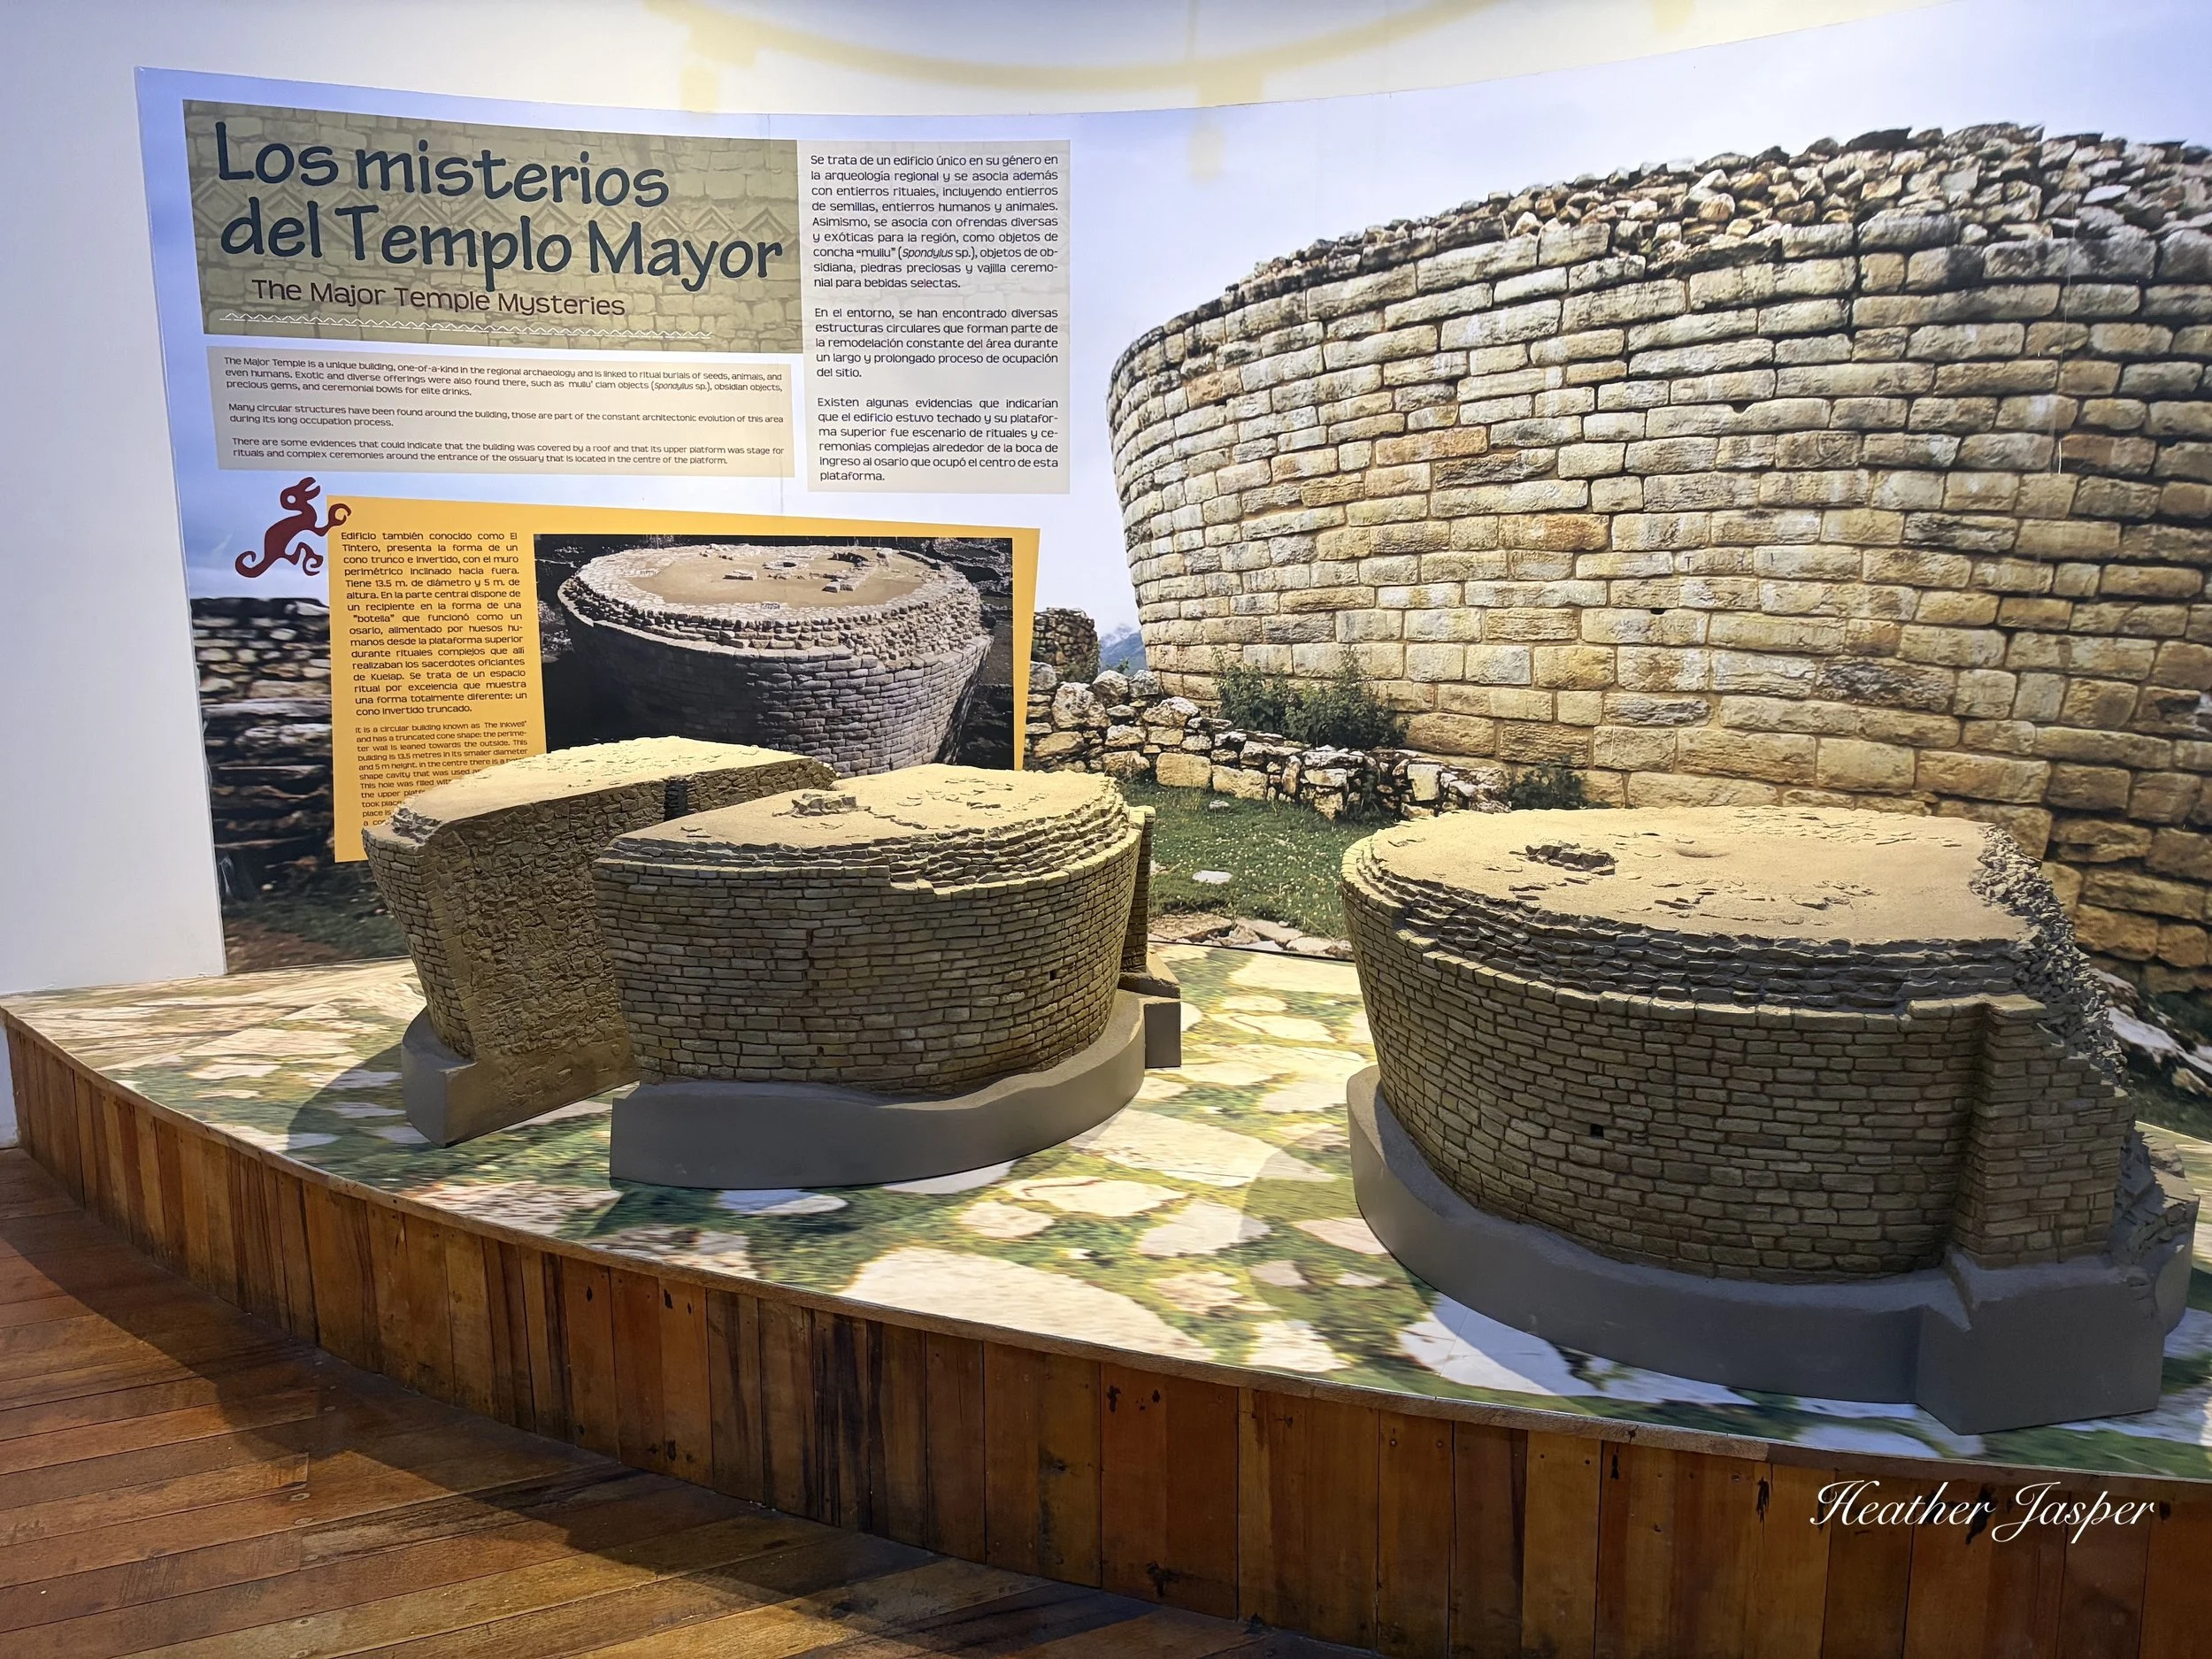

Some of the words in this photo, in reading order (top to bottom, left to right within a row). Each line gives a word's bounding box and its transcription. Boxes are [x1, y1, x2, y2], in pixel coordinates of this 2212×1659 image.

[215, 121, 339, 187] Los
[356, 139, 670, 208] misterios
[810, 155, 825, 165] Se
[827, 156, 857, 165] trata
[859, 156, 874, 165] de
[876, 157, 891, 165] un
[893, 156, 934, 166] edificio
[936, 156, 967, 166] único
[969, 157, 984, 166] en
[986, 157, 1000, 166] su
[1002, 155, 1042, 167] género
[1044, 156, 1058, 165] en
[811, 171, 821, 180] la
[825, 170, 891, 183] arqueología
[895, 171, 940, 183] regional
[942, 173, 951, 183] y
[954, 173, 969, 181] se
[972, 171, 1009, 181] asocia
[1012, 170, 1059, 181] además
[811, 188, 833, 196] con
[836, 187, 890, 196] entierros
[893, 187, 940, 199] rituales,
[942, 187, 1002, 199] incluyendo
[1006, 187, 1059, 196] entierros
[811, 202, 826, 211] de
[830, 202, 879, 213] semillas,
[882, 202, 935, 212] entierros
[938, 203, 992, 212] humanos
[995, 204, 1002, 214] y
[1005, 202, 1058, 212] animales.
[812, 217, 871, 228] Asimismo,
[873, 219, 888, 227] se
[891, 218, 928, 227] asocia
[931, 219, 953, 227] con
[956, 218, 1008, 227] ofrendas
[1010, 217, 1059, 227] diversas
[219, 196, 323, 258] del
[334, 204, 572, 292] Templo
[588, 219, 784, 293] Mayor
[251, 279, 303, 302] The
[310, 282, 387, 308] Major
[394, 287, 490, 313] Temple
[497, 293, 626, 316] Mysteries
[815, 308, 828, 318] En
[833, 308, 842, 318] el
[847, 309, 895, 320] entorno,
[899, 310, 913, 319] se
[917, 309, 938, 319] han
[942, 309, 1007, 319] encontrado
[1011, 309, 1058, 319] diversas
[815, 323, 884, 334] estructuras
[886, 324, 941, 334] circulares
[943, 325, 964, 335] que
[966, 324, 1009, 334] forman
[1010, 324, 1042, 335] parte
[1044, 324, 1058, 334] de
[224, 356, 242, 365] The
[243, 357, 271, 367] Major
[272, 357, 306, 369] Temple
[308, 359, 317, 368] is
[326, 360, 357, 371] unique
[358, 361, 396, 373] building,
[397, 364, 459, 374] one-of-a-kind
[460, 365, 469, 374] in
[470, 365, 486, 374] the
[487, 366, 522, 376] regional
[523, 368, 576, 379] archaeology
[603, 370, 627, 379] linked
[628, 370, 639, 379] to
[663, 371, 691, 380] burials
[703, 372, 731, 381] seeds,
[731, 372, 766, 382] animals,
[766, 373, 783, 381] and
[816, 367, 833, 378] del
[835, 368, 862, 378] sitio.
[227, 380, 269, 389] precious
[270, 381, 301, 391] gems,
[302, 382, 320, 391] and
[322, 383, 374, 393] ceremonial
[375, 384, 403, 394] bowls
[404, 385, 419, 395] for
[420, 386, 441, 396] elite
[442, 387, 472, 396] drinks.
[818, 397, 860, 407] Existen
[866, 398, 910, 410] algunas
[916, 398, 973, 409] evidencias
[979, 400, 1000, 410] que
[1006, 398, 1059, 409] indicarían
[229, 414, 261, 425] during
[262, 414, 276, 424] its
[278, 415, 298, 426] long
[299, 416, 352, 426] occupation
[353, 418, 394, 427] process.
[818, 413, 839, 423] que
[841, 412, 851, 422] el
[853, 412, 894, 423] edificio
[895, 413, 934, 423] estuvo
[936, 413, 982, 424] techado
[984, 415, 992, 425] y
[994, 415, 1008, 424] su
[1010, 413, 1058, 425] platafor-
[344, 567, 403, 576] perimétrico
[426, 704, 472, 713] truncado.
[428, 741, 462, 749] towards
[480, 739, 511, 748] outside.
